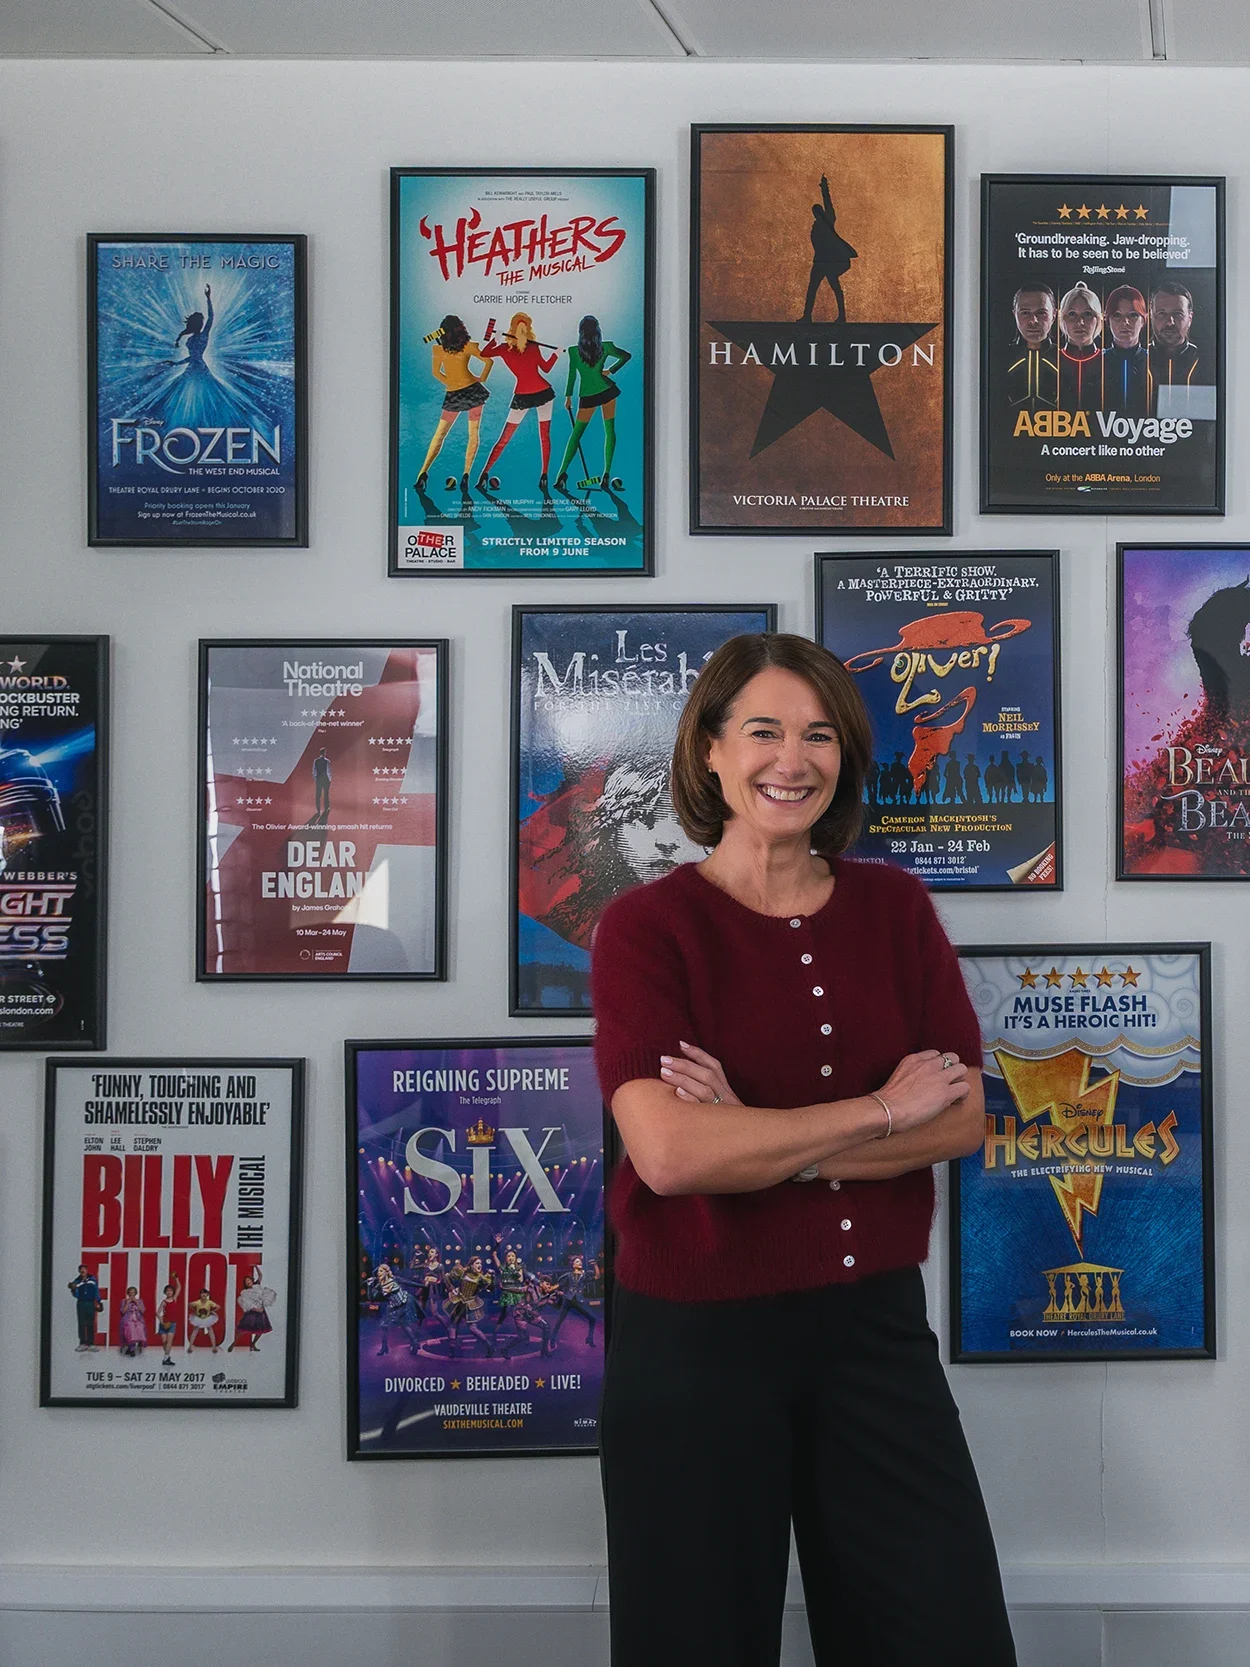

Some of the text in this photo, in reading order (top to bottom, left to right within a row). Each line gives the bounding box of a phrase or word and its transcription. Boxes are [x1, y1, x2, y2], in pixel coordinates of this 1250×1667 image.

[1113, 233, 1190, 247] Jaw-dropping.
[1019, 248, 1027, 259] It
[1029, 248, 1048, 259] has
[1051, 248, 1063, 259] to
[1066, 248, 1080, 259] be
[1082, 248, 1108, 259] seen
[1111, 248, 1122, 259] to
[1126, 248, 1140, 259] be
[112, 255, 280, 271] SHARE THE MAGIC
[709, 341, 935, 367] HAMILTON
[1095, 411, 1193, 443] Voyage
[110, 418, 281, 475] FROZEN
[1041, 445, 1166, 457] A concert like no other
[189, 468, 280, 476] THE WEST END MUSICAL
[733, 496, 909, 507] VICTORIA PALACE THEATRE
[482, 538, 626, 547] STRICTLY LIMITED SEASON
[520, 548, 589, 557] FROM 9 JUNE
[615, 630, 668, 663] Les
[283, 661, 363, 679] National
[283, 679, 363, 697] Theatre
[22, 705, 79, 717] RETURN.
[999, 713, 1024, 722] NEIL
[982, 722, 1040, 732] MORRISSEY
[288, 823, 336, 832] Award-winning
[1227, 831, 1245, 840] THE
[891, 840, 991, 853] 22 Jan 24 Feb
[287, 841, 356, 868] DEAR
[8, 994, 44, 1003] STREET
[1014, 995, 1147, 1014] MUSE FLASH
[149, 1075, 221, 1098] TOUCHING
[226, 1075, 256, 1098] AND
[393, 1069, 569, 1093] REIGNING SUPREME
[985, 1109, 1180, 1169] HERCULES
[403, 1126, 572, 1216] SIX
[81, 1154, 235, 1249] BILLY
[1010, 1327, 1158, 1337] BOOK NOW HerculesTheMusical.co.uk
[86, 1372, 205, 1382] TUE 9 SAT 27 MAY 2017
[385, 1375, 581, 1393] DIVORCED BEHEADED LIVE!
[434, 1403, 532, 1416] VAUDEVILLE THEATRE
